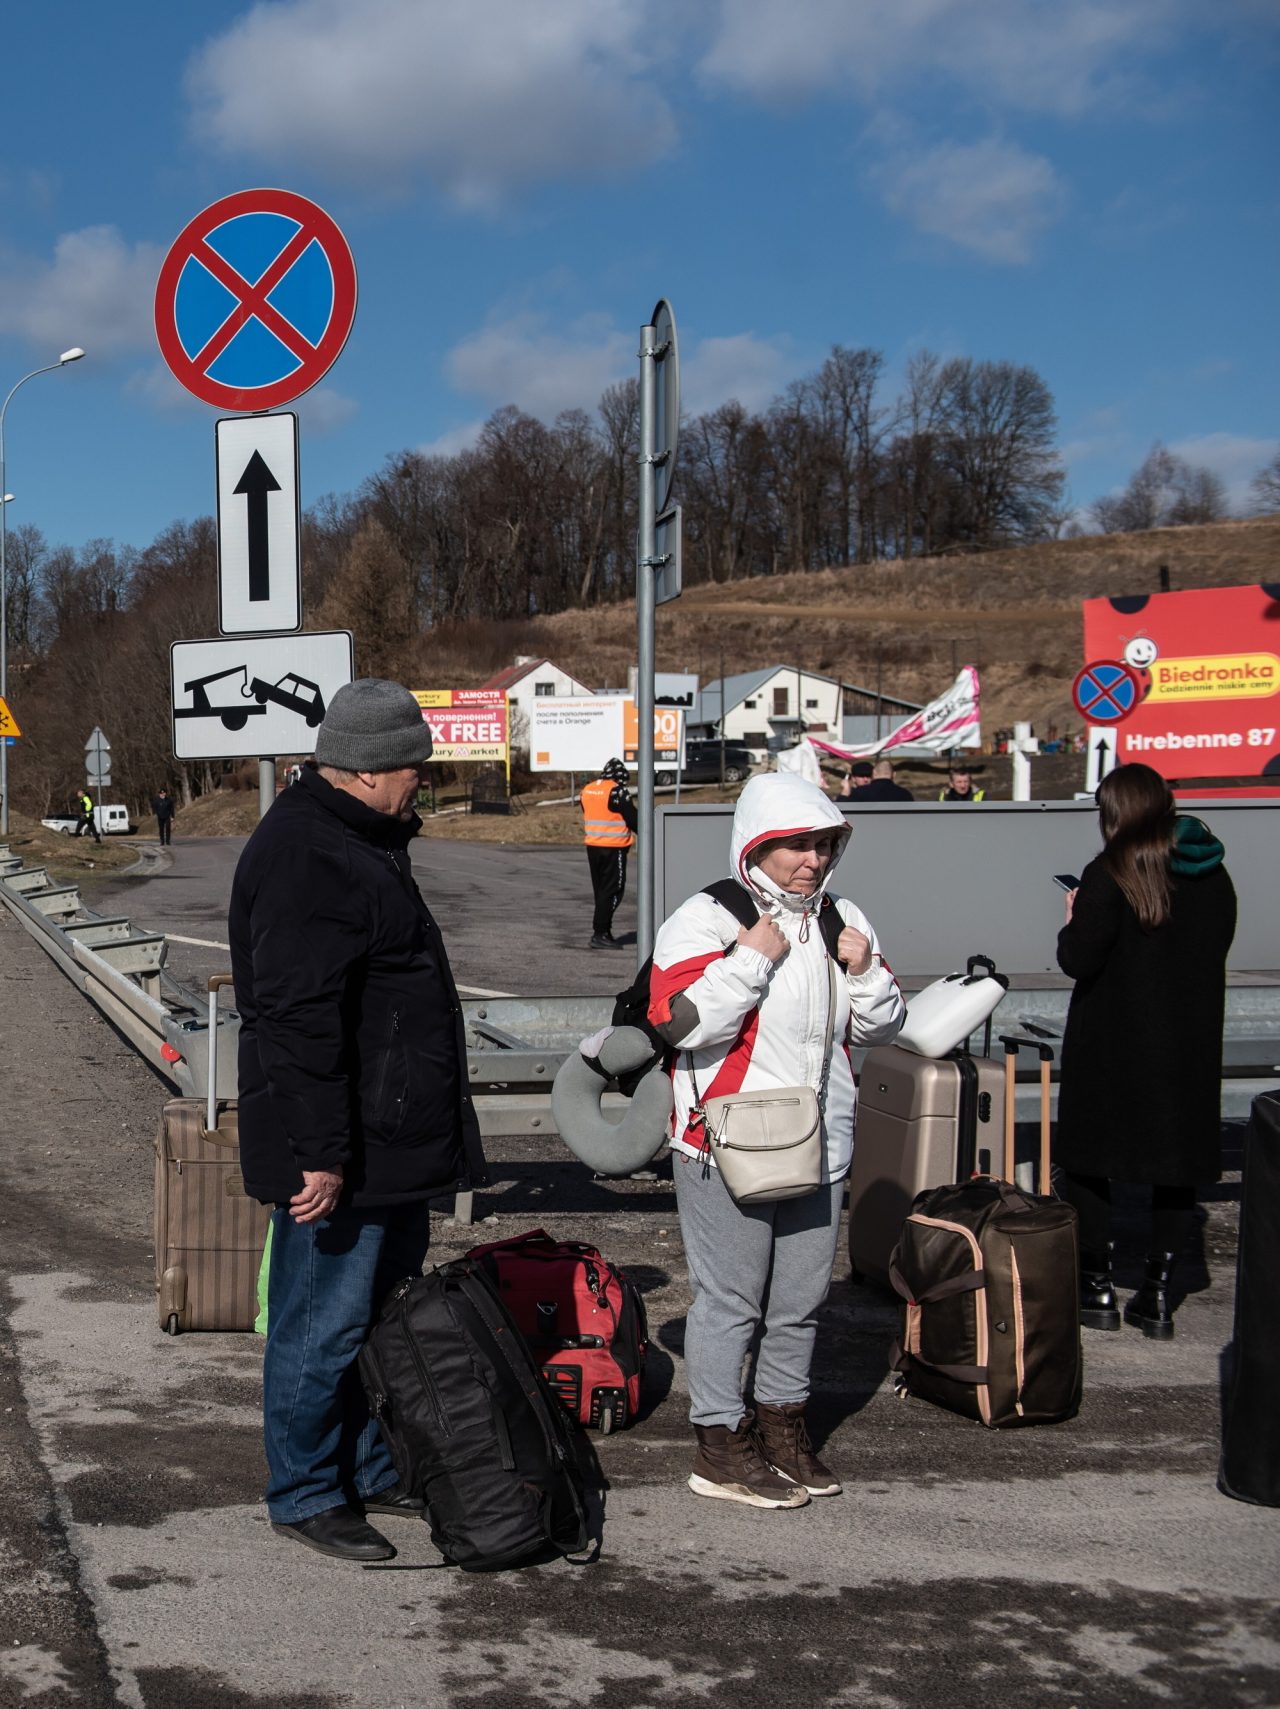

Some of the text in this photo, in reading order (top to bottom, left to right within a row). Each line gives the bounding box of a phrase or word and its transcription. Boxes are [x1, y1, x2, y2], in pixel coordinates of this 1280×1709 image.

[1160, 663, 1274, 683] Biedronka
[1160, 681, 1274, 693] Codziennie niskie ceny
[459, 691, 500, 699] ЗАМОСТЯ
[433, 712, 497, 723] повернення!
[429, 723, 501, 742] X FREE
[1126, 728, 1276, 751] Hrebenne 87
